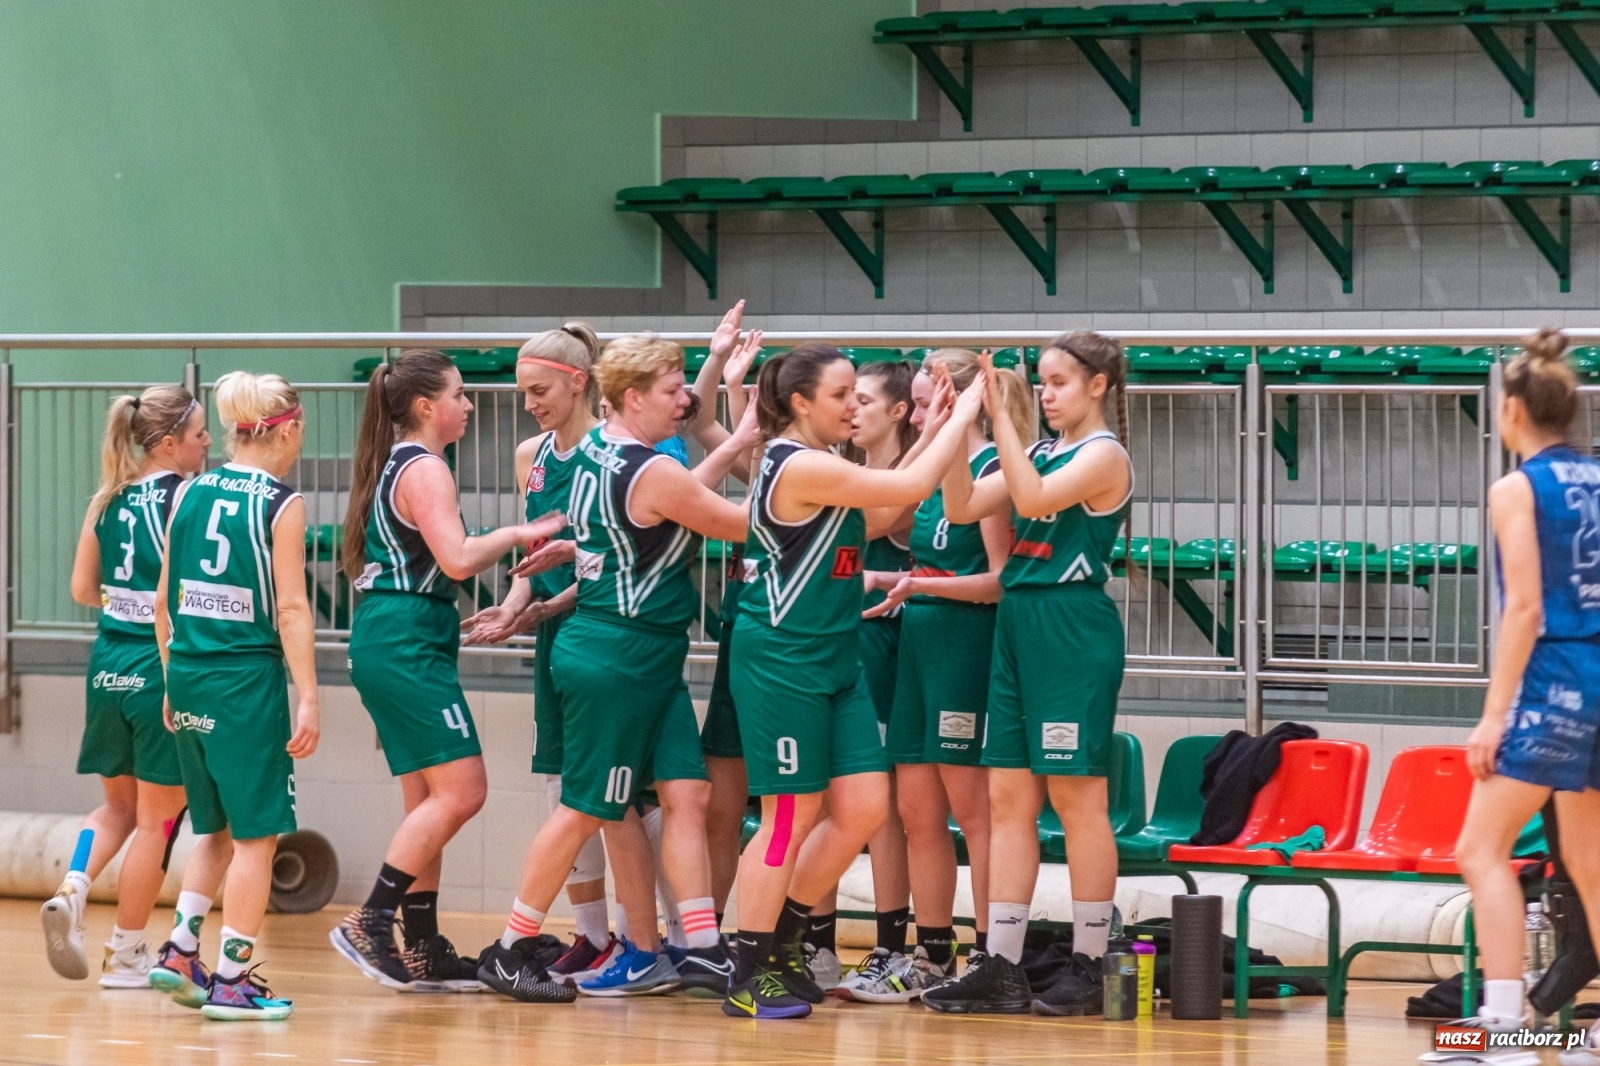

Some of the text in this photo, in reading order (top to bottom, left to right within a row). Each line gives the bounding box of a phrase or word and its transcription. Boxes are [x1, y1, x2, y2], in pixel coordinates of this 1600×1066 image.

[220, 477, 280, 500] RACIBÓRZ
[567, 464, 598, 542] 10
[114, 507, 137, 581] 3
[200, 498, 240, 576] 5
[932, 517, 950, 550] 8
[185, 595, 251, 615] WAGTECH
[102, 672, 146, 688] Clavis
[180, 711, 216, 730] Clavis
[442, 703, 470, 738] 4
[776, 736, 799, 775] 9
[604, 766, 632, 803] 10
